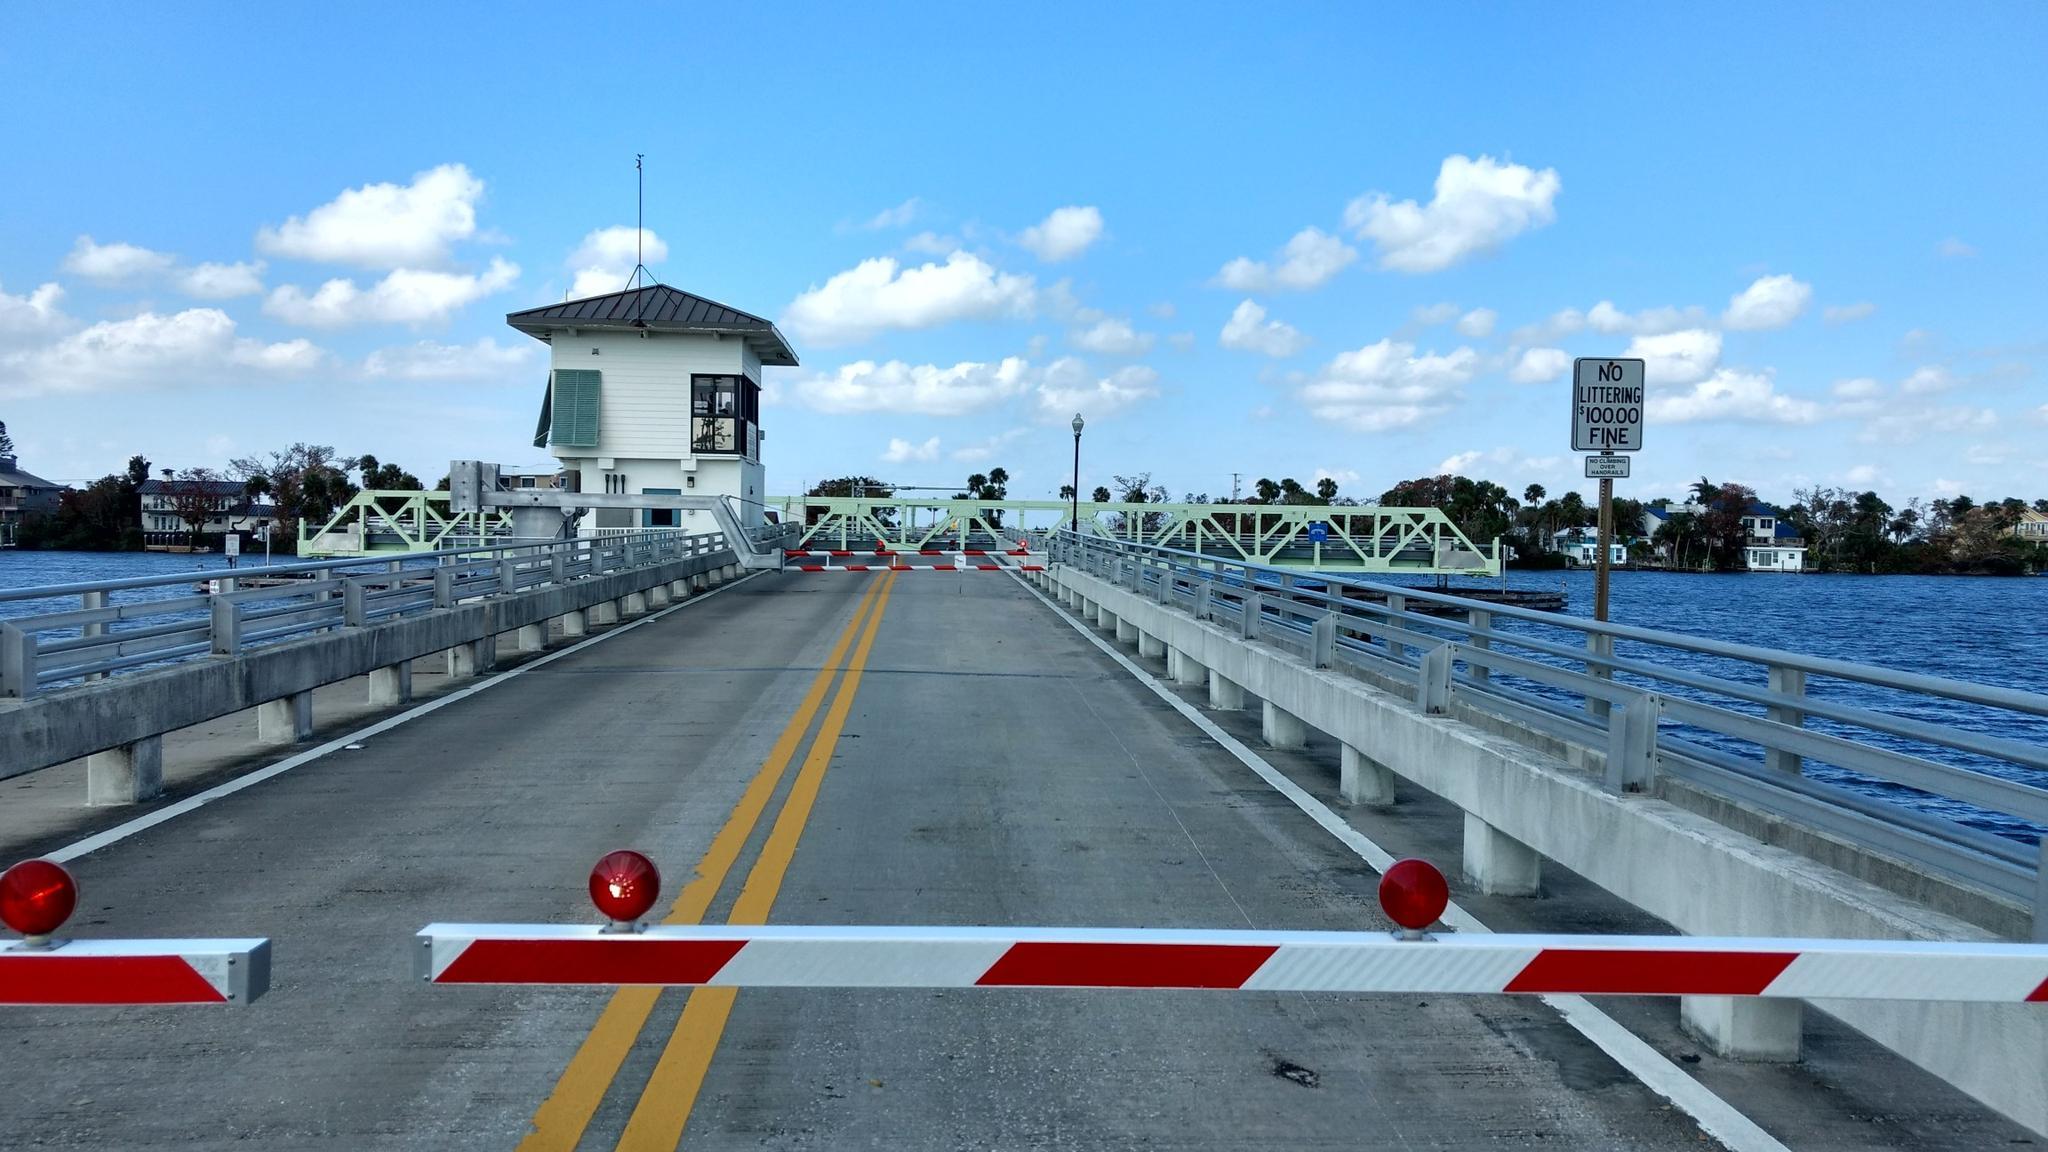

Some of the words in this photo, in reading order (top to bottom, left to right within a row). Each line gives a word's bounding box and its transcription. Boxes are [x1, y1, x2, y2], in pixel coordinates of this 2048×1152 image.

[1598, 364, 1623, 382] NO
[1580, 386, 1641, 404] LITTERING
[1579, 405, 1639, 424] $100.00
[1589, 427, 1629, 445] FINE
